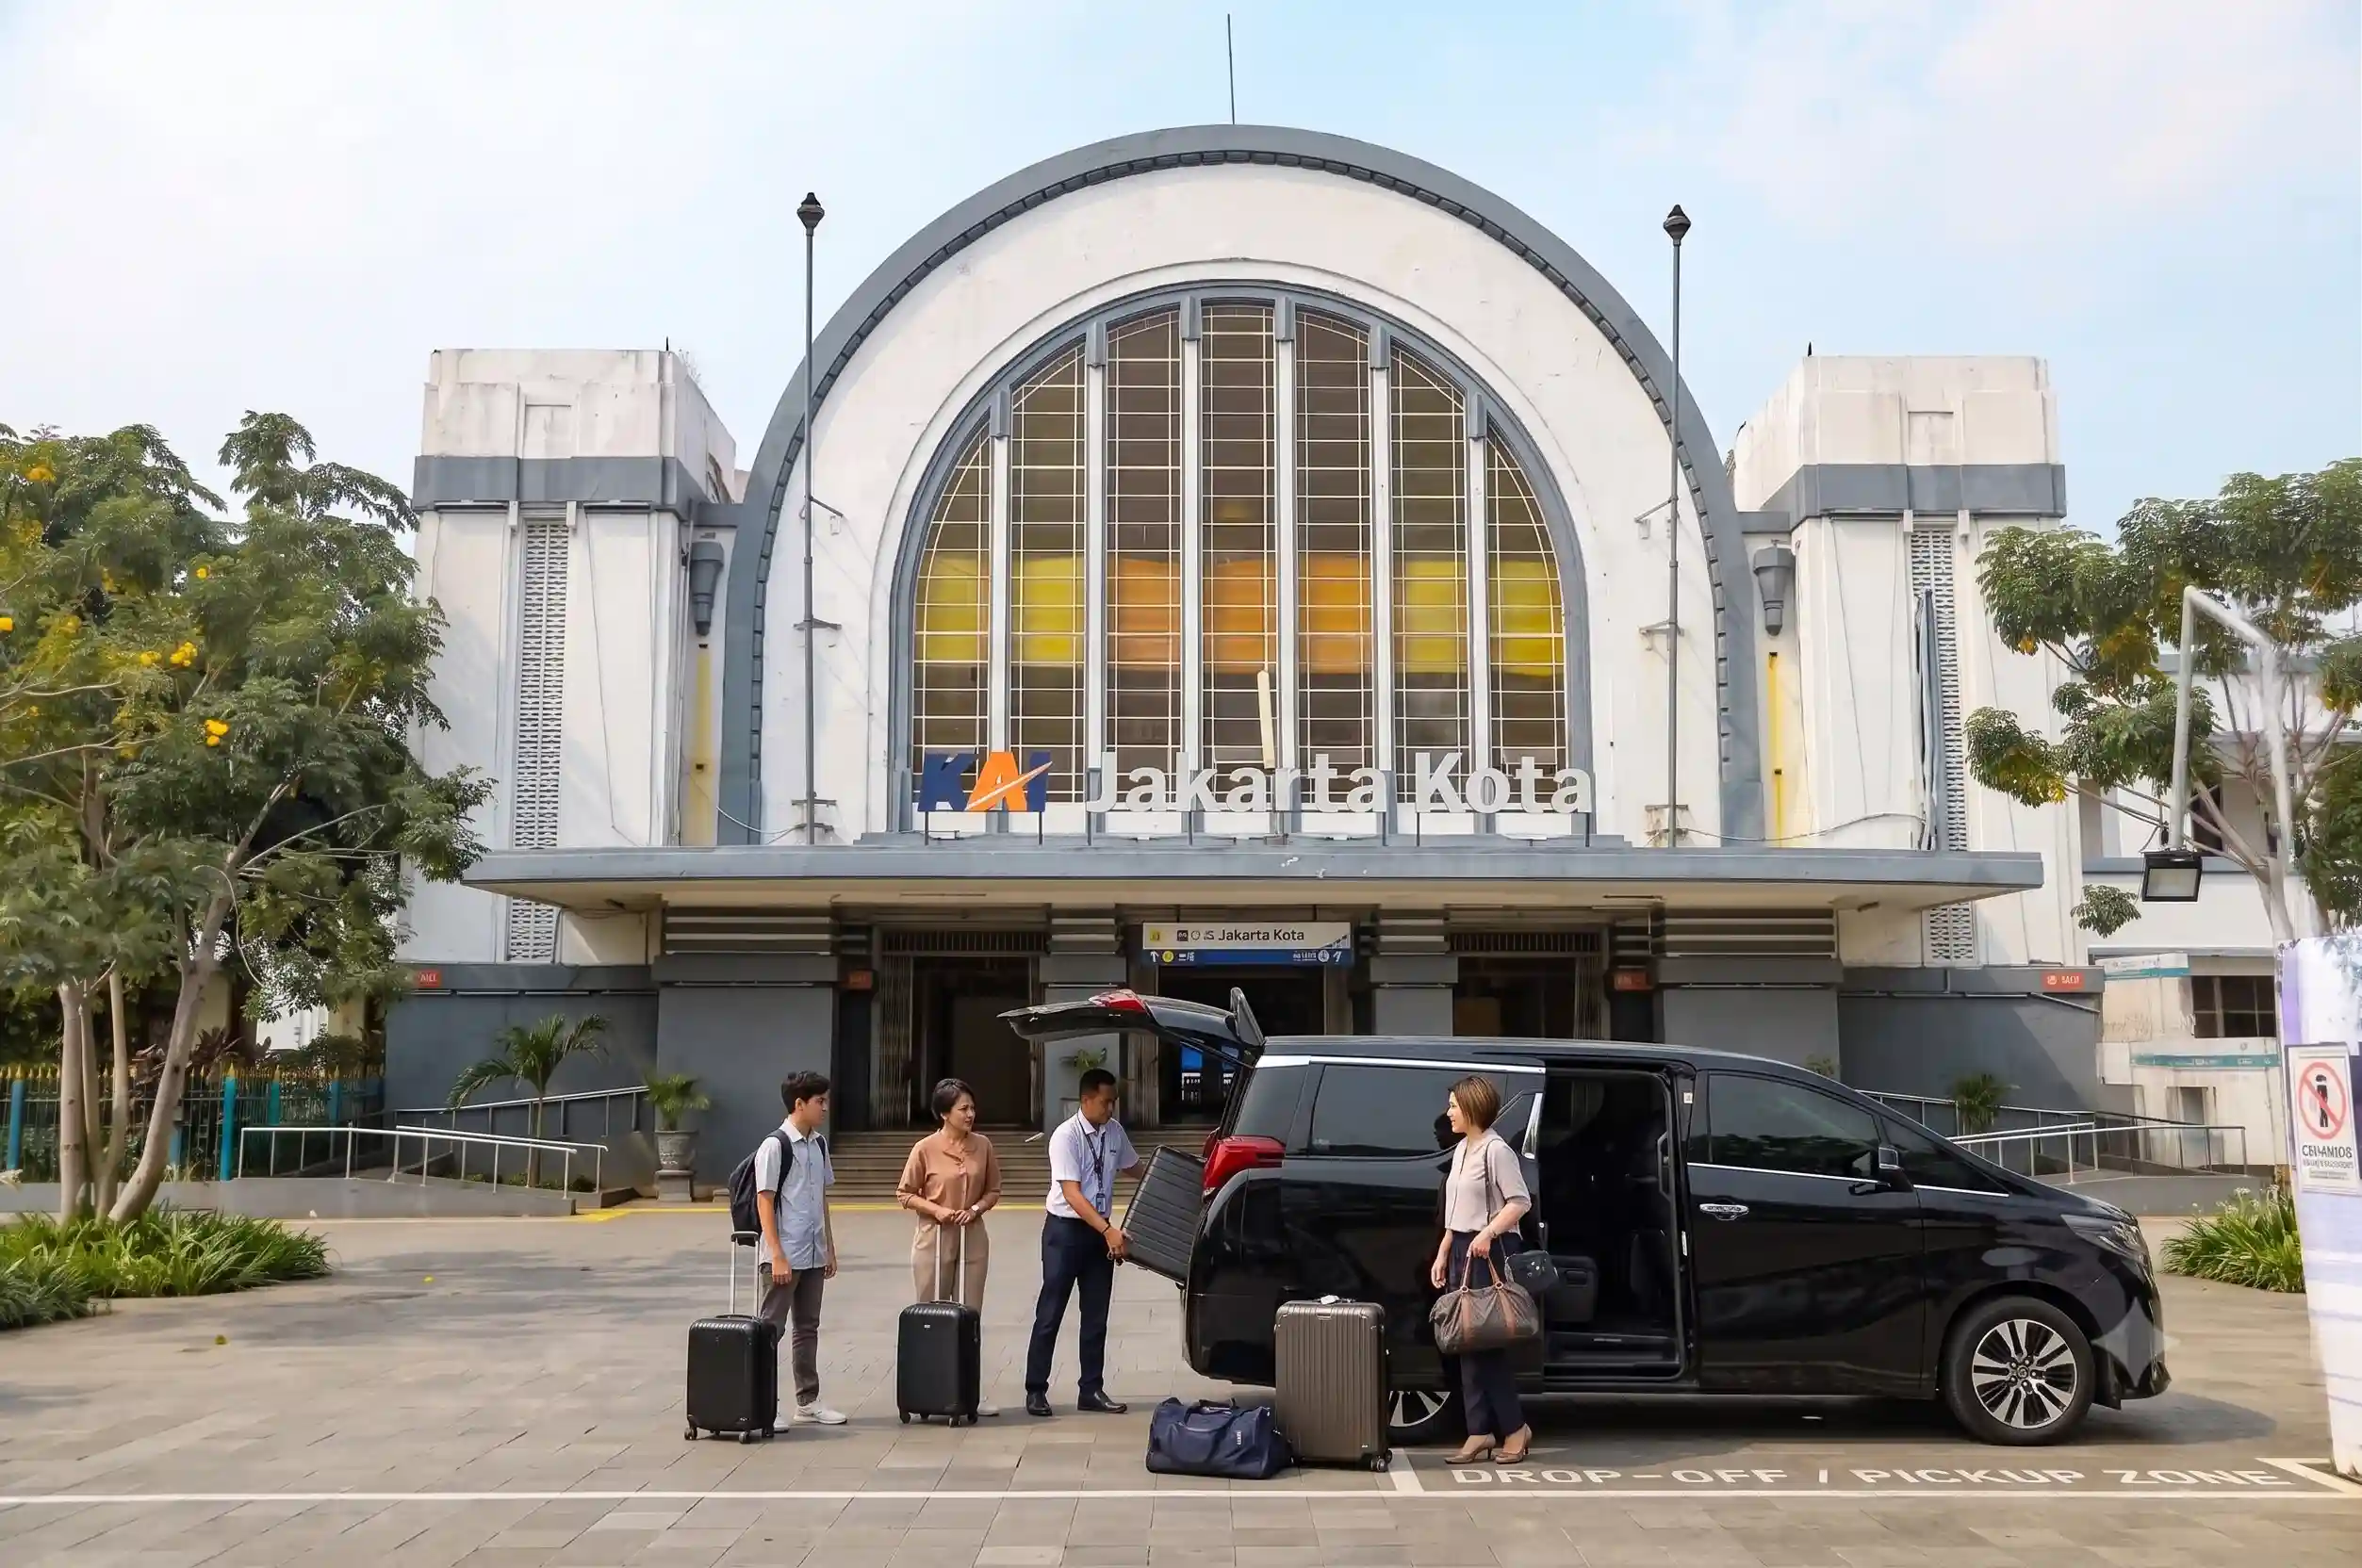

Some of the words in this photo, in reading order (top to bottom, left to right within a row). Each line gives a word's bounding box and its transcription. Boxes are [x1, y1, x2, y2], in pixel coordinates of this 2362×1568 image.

[917, 751, 1053, 812] KAI
[1087, 751, 1386, 813] Jakarta
[1415, 751, 1591, 813] Kota
[1218, 929, 1270, 940] Jakarta
[1273, 929, 1304, 940] Kota
[1848, 1469, 2086, 1484] PICKUP
[2101, 1469, 2297, 1485] ZONE
